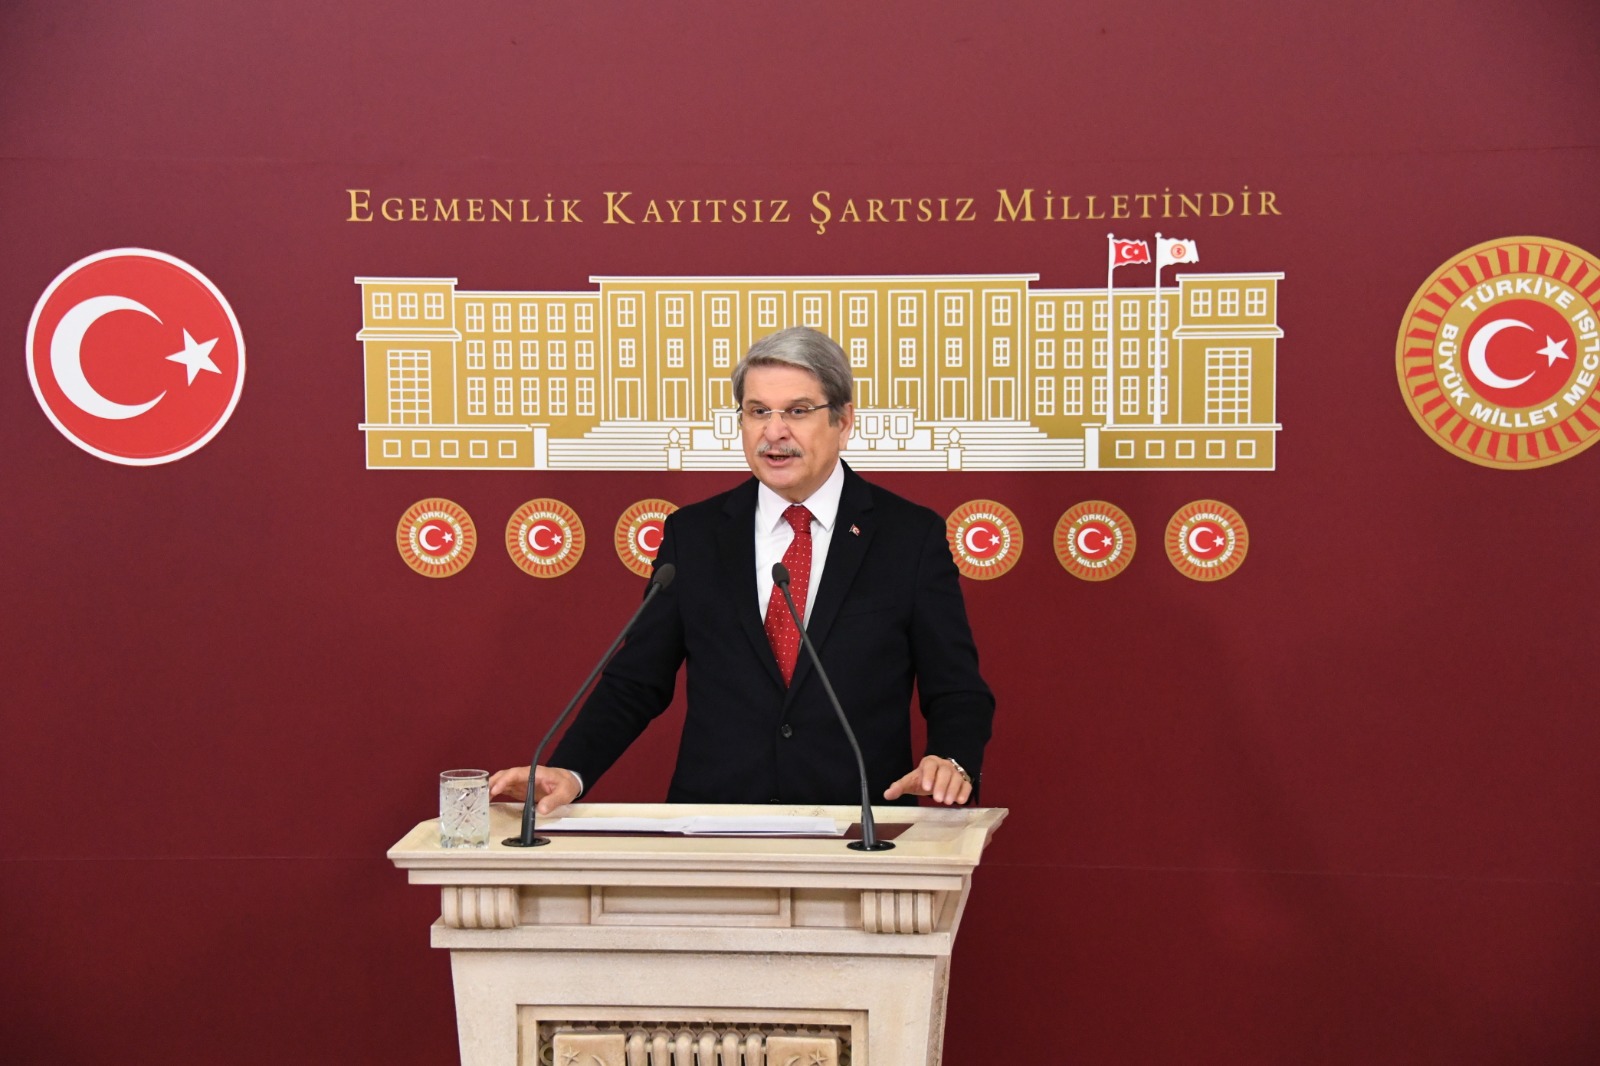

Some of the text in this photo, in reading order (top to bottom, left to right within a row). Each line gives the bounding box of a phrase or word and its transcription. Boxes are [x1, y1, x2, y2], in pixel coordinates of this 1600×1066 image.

[346, 185, 1282, 235] EGEMENLİK KAYITSIZ ŞARTSIZ MİLLETİNDİR
[1460, 277, 1575, 313] TÜRKİYE
[1438, 323, 1471, 406] BÜYÜK
[1469, 402, 1560, 428] MİLLET
